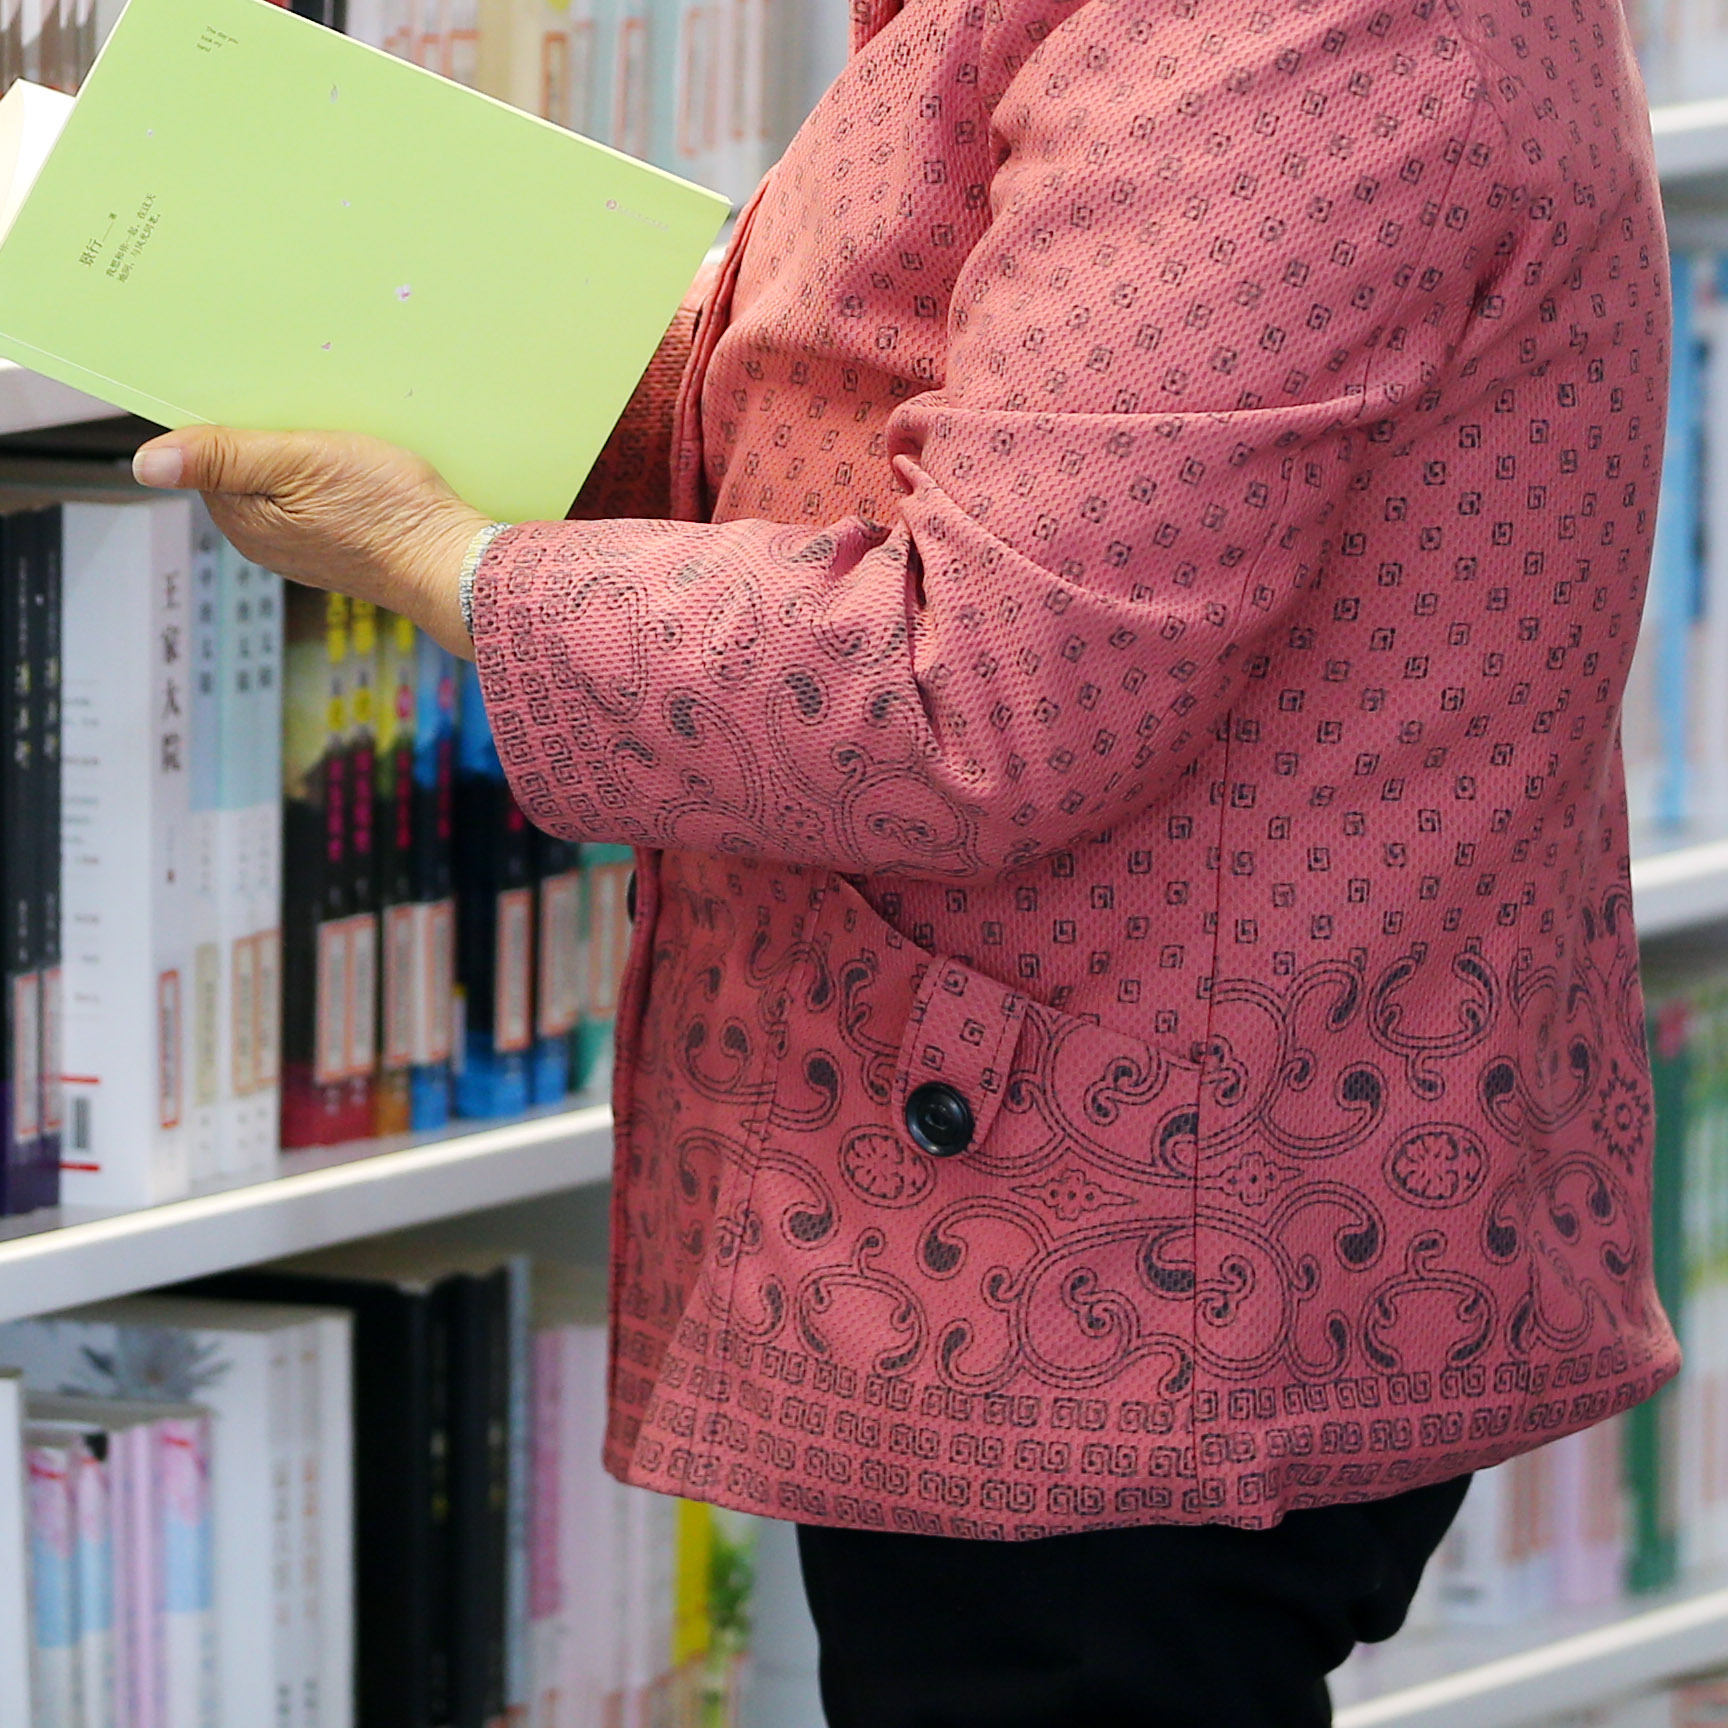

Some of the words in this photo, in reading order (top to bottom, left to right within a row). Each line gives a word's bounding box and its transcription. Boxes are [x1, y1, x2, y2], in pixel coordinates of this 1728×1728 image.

[78, 238, 103, 266] 景行
[158, 571, 184, 775] 王家大院
